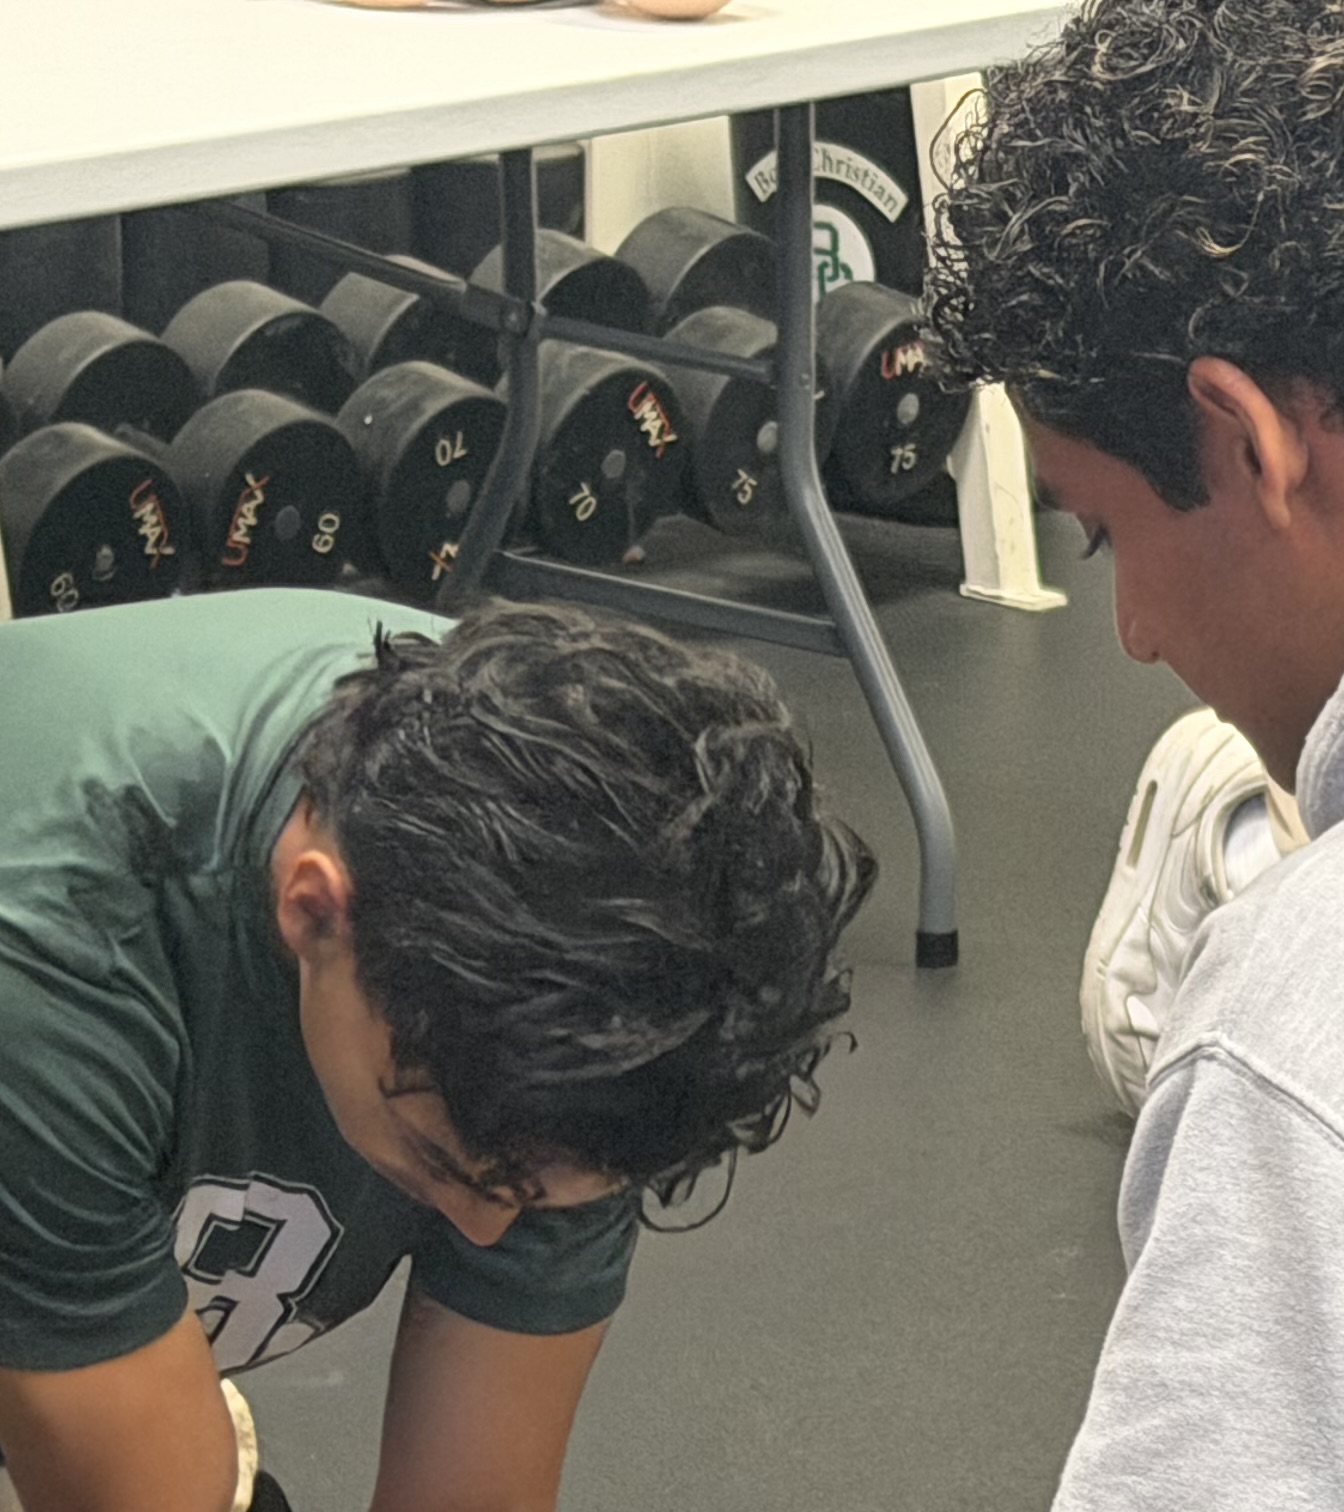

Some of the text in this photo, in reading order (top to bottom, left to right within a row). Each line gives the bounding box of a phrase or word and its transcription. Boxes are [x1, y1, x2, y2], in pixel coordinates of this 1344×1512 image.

[813, 145, 901, 215] hristian
[435, 430, 469, 467] 70
[890, 443, 917, 474] 75
[568, 481, 598, 522] 70
[732, 468, 758, 505] 75
[221, 472, 271, 567] UMAX
[311, 511, 341, 554] 60
